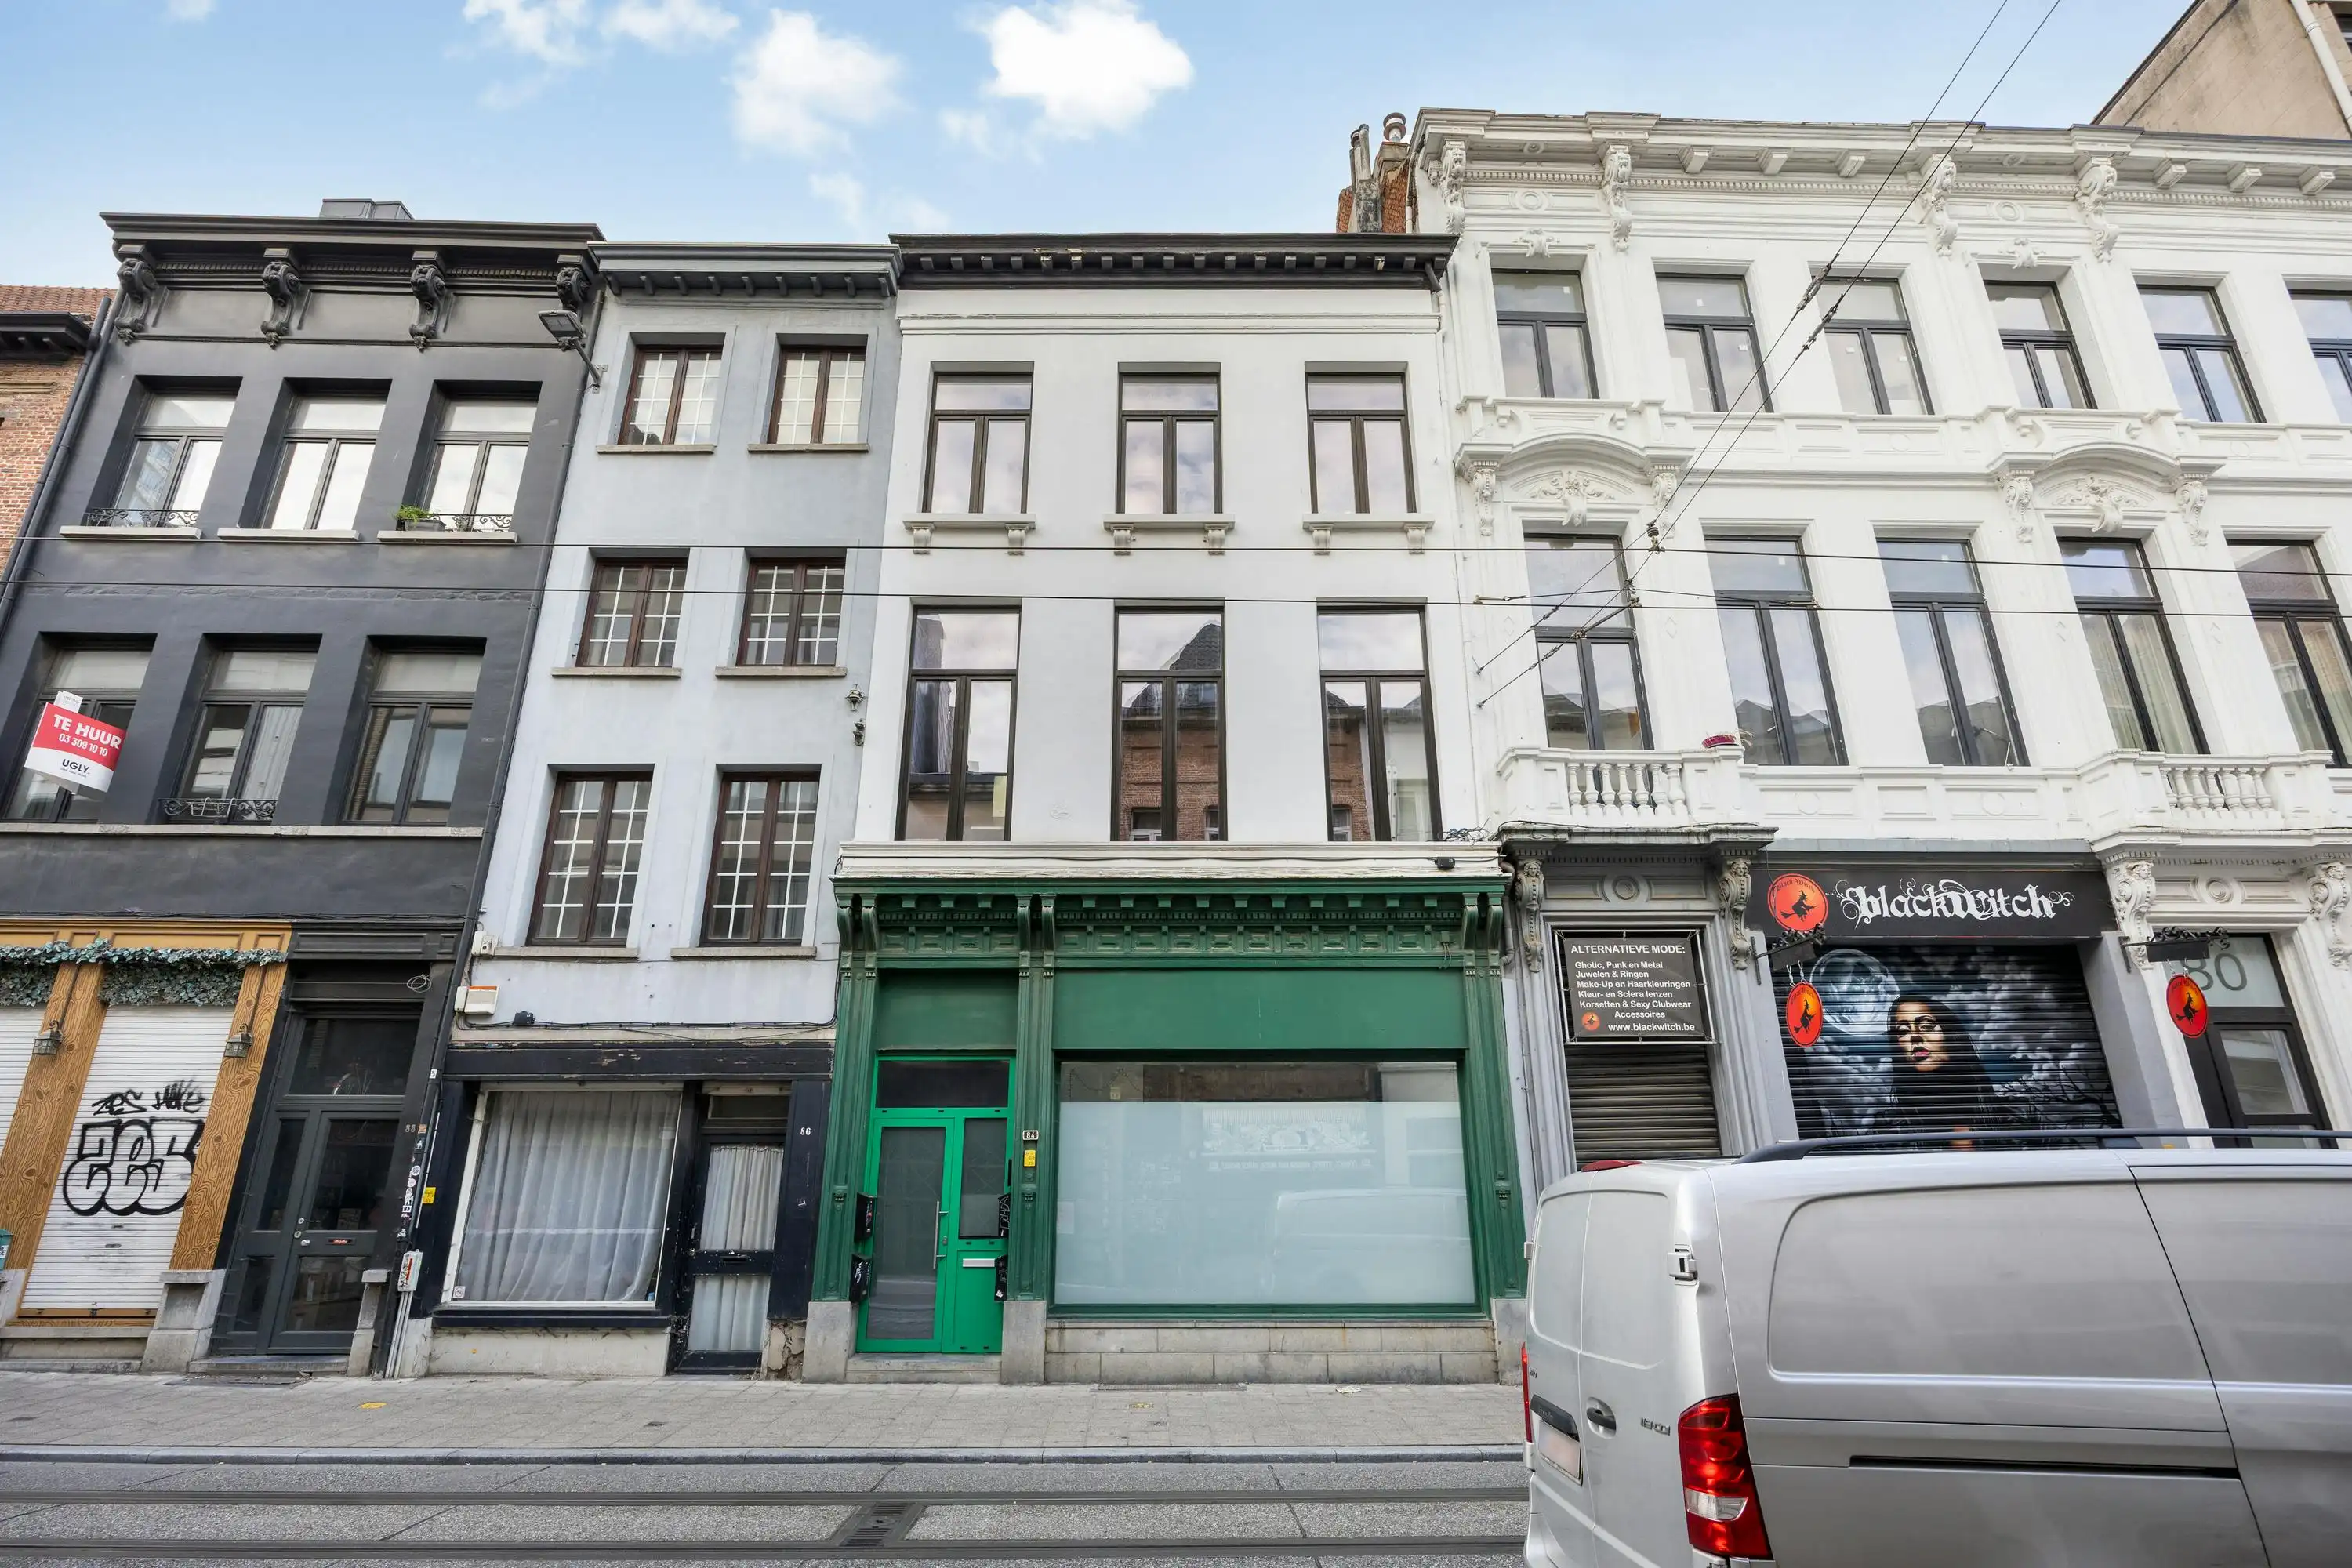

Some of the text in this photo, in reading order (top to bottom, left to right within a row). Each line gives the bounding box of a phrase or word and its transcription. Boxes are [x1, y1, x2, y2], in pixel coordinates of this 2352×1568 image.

[53, 714, 122, 750] TE HUUR
[59, 733, 108, 757] 03 309 10 10
[62, 758, 89, 774] UGLY
[1571, 945, 1686, 953] ALTERNATIEVE MODE:
[1575, 961, 1605, 970] Ghotic,
[1620, 971, 1649, 980] Ringen
[1577, 981, 1613, 989] Make-Up
[1627, 980, 1691, 989] Haarkleuringen
[1631, 1000, 1650, 1010] Sexy
[1652, 1000, 1692, 1008] Clubwear
[1608, 1022, 1695, 1031] www.blackwitch.be
[405, 1123, 416, 1133] 88
[800, 1127, 811, 1136] 86
